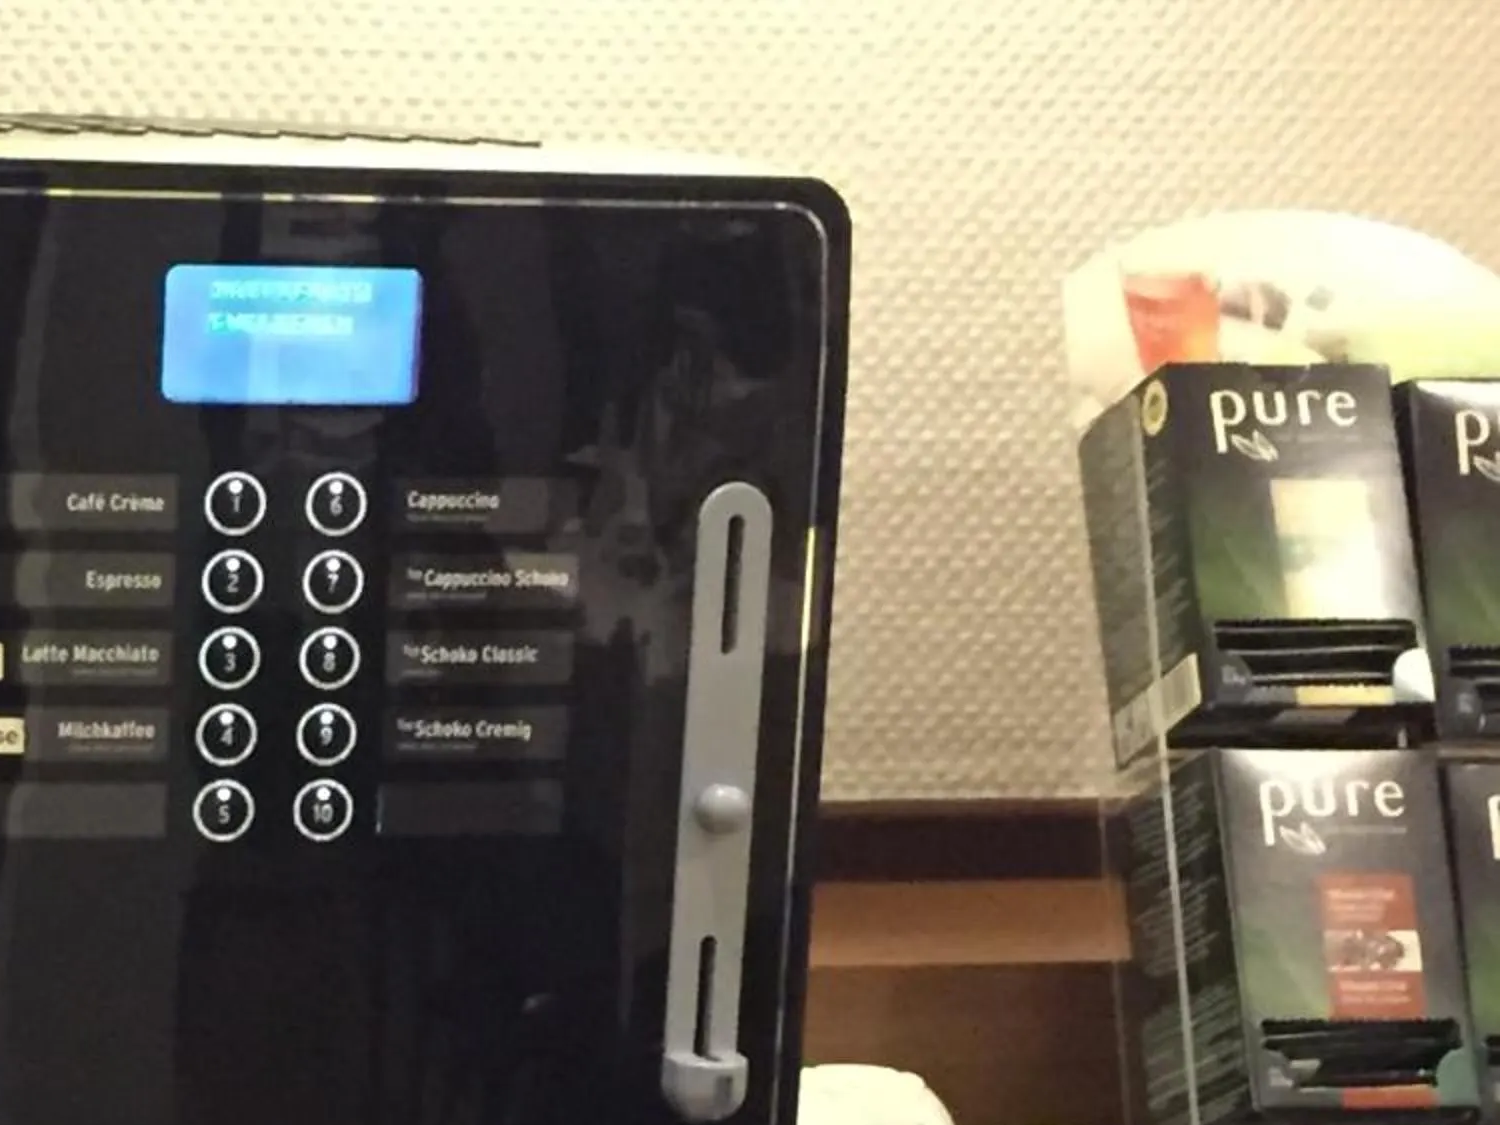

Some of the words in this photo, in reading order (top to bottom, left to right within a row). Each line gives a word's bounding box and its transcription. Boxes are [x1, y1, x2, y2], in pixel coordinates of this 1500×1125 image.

[1210, 388, 1357, 454] pure
[1455, 408, 1500, 476] p
[232, 495, 241, 512] 1
[329, 496, 343, 517] 6
[407, 490, 500, 513] Cappuccino
[85, 569, 162, 592] Espresso
[226, 573, 239, 593] 2
[326, 573, 339, 593] 7
[423, 568, 512, 590] Cappuccino
[21, 644, 69, 663] Latte
[72, 644, 160, 663] Macchiato
[224, 652, 237, 672] 3
[322, 652, 336, 672] 8
[420, 645, 478, 664] Schoko
[481, 645, 539, 664] Classic
[57, 721, 156, 740] Milchkaffee
[220, 727, 233, 745] 4
[320, 726, 333, 745] 9
[414, 720, 473, 739] Schoko
[475, 720, 532, 742] Cremig
[217, 804, 231, 824] 5
[312, 803, 334, 823] 10
[1259, 779, 1406, 846] pure
